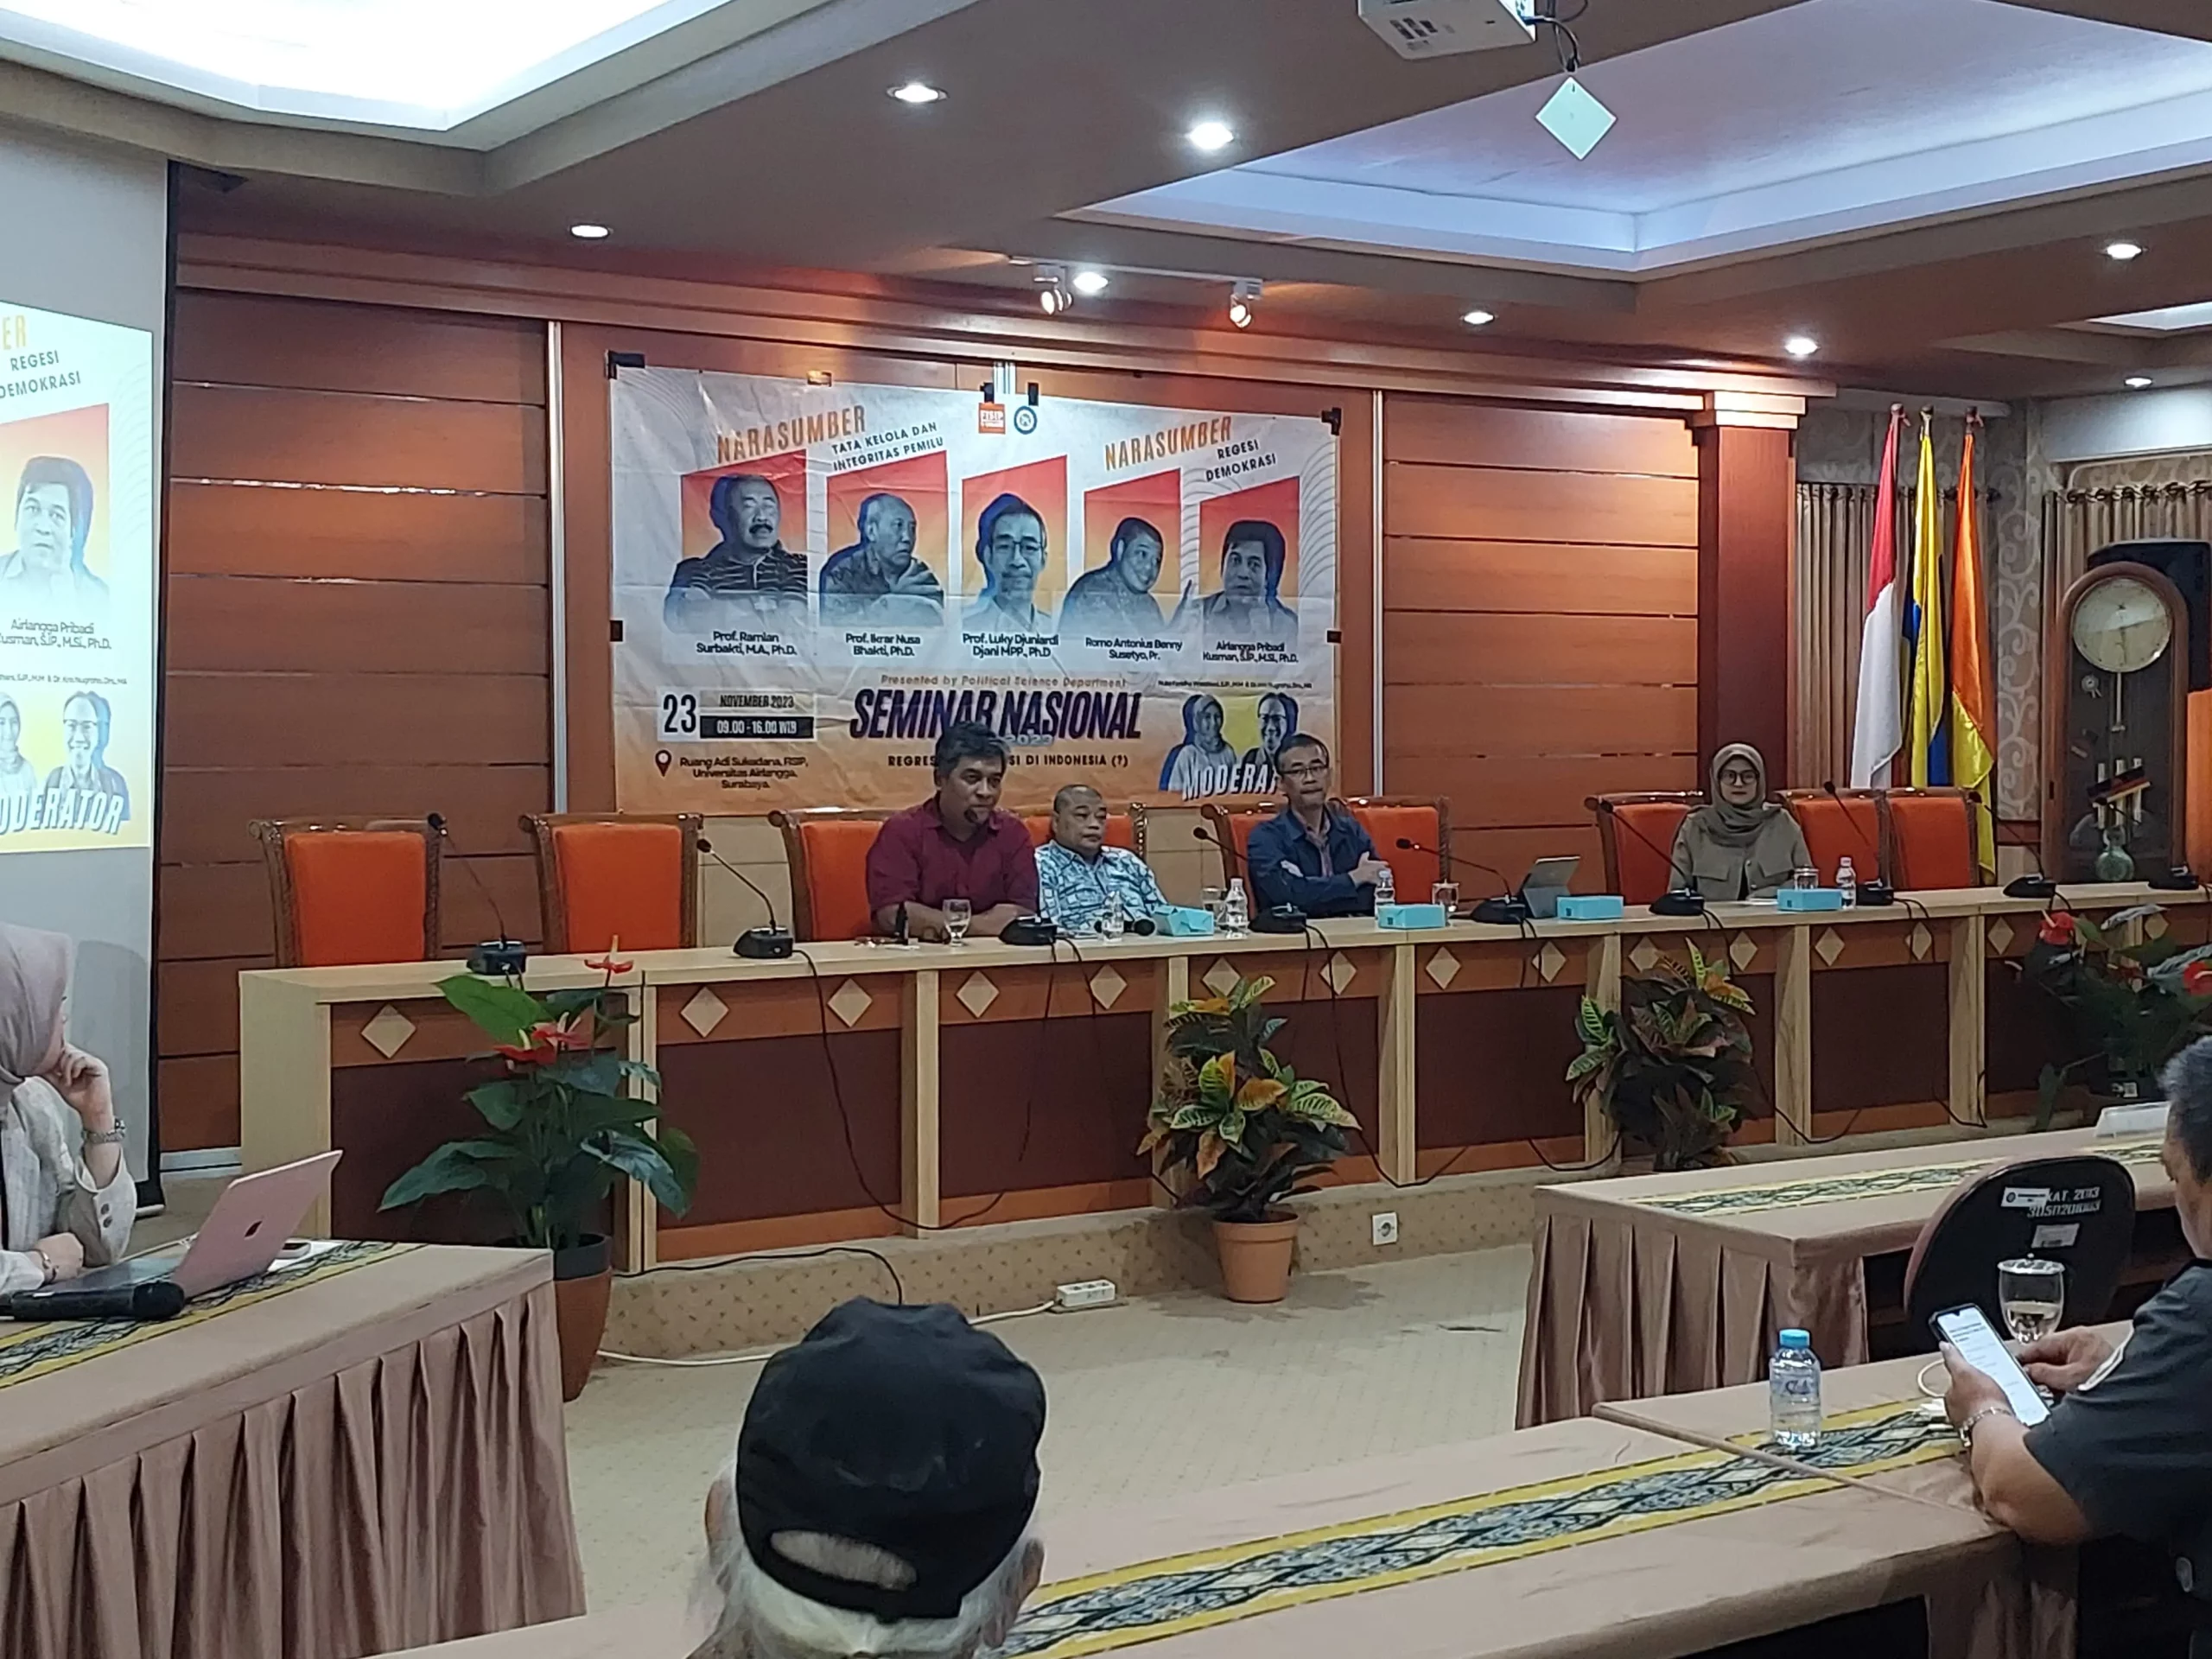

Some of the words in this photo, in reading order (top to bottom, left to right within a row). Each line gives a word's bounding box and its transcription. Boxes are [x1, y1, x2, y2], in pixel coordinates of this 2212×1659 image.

[10, 350, 60, 372] REGESI
[0, 371, 81, 398] DEMOKRASI
[717, 404, 866, 463] NARASUMBER
[831, 442, 862, 455] TATA
[865, 429, 908, 448] KELOLA
[912, 422, 938, 436] DAN
[1104, 416, 1232, 471] NARASUMBER
[832, 449, 900, 472] INTEGRITAS
[904, 437, 944, 456] PEMILU
[1217, 439, 1259, 460] REGESI
[1205, 453, 1276, 482] DEMOKRASI
[0, 632, 39, 646] usman,
[846, 632, 868, 643] Prof.
[896, 634, 920, 644] Nusa
[963, 632, 988, 644] Prof.
[988, 633, 1013, 647] Luky
[880, 674, 938, 685] Presented
[943, 676, 957, 686] by
[962, 676, 1010, 686] Political
[1014, 676, 1058, 687] Science
[1063, 677, 1127, 689] Department
[663, 694, 697, 733] 23
[719, 695, 770, 707] NOVEMBER
[770, 695, 794, 708] 2023
[849, 689, 996, 739] SEMINAR
[999, 690, 1142, 740] NASIONAL
[716, 720, 745, 734] 09.00
[753, 721, 777, 734] 16.00
[779, 721, 798, 734] WIB
[888, 756, 938, 766] REGRES
[1026, 755, 1039, 765] DI
[1044, 754, 1107, 766] INDONESIA
[1111, 755, 1128, 767] (?)
[0, 786, 124, 836] ODERATOR
